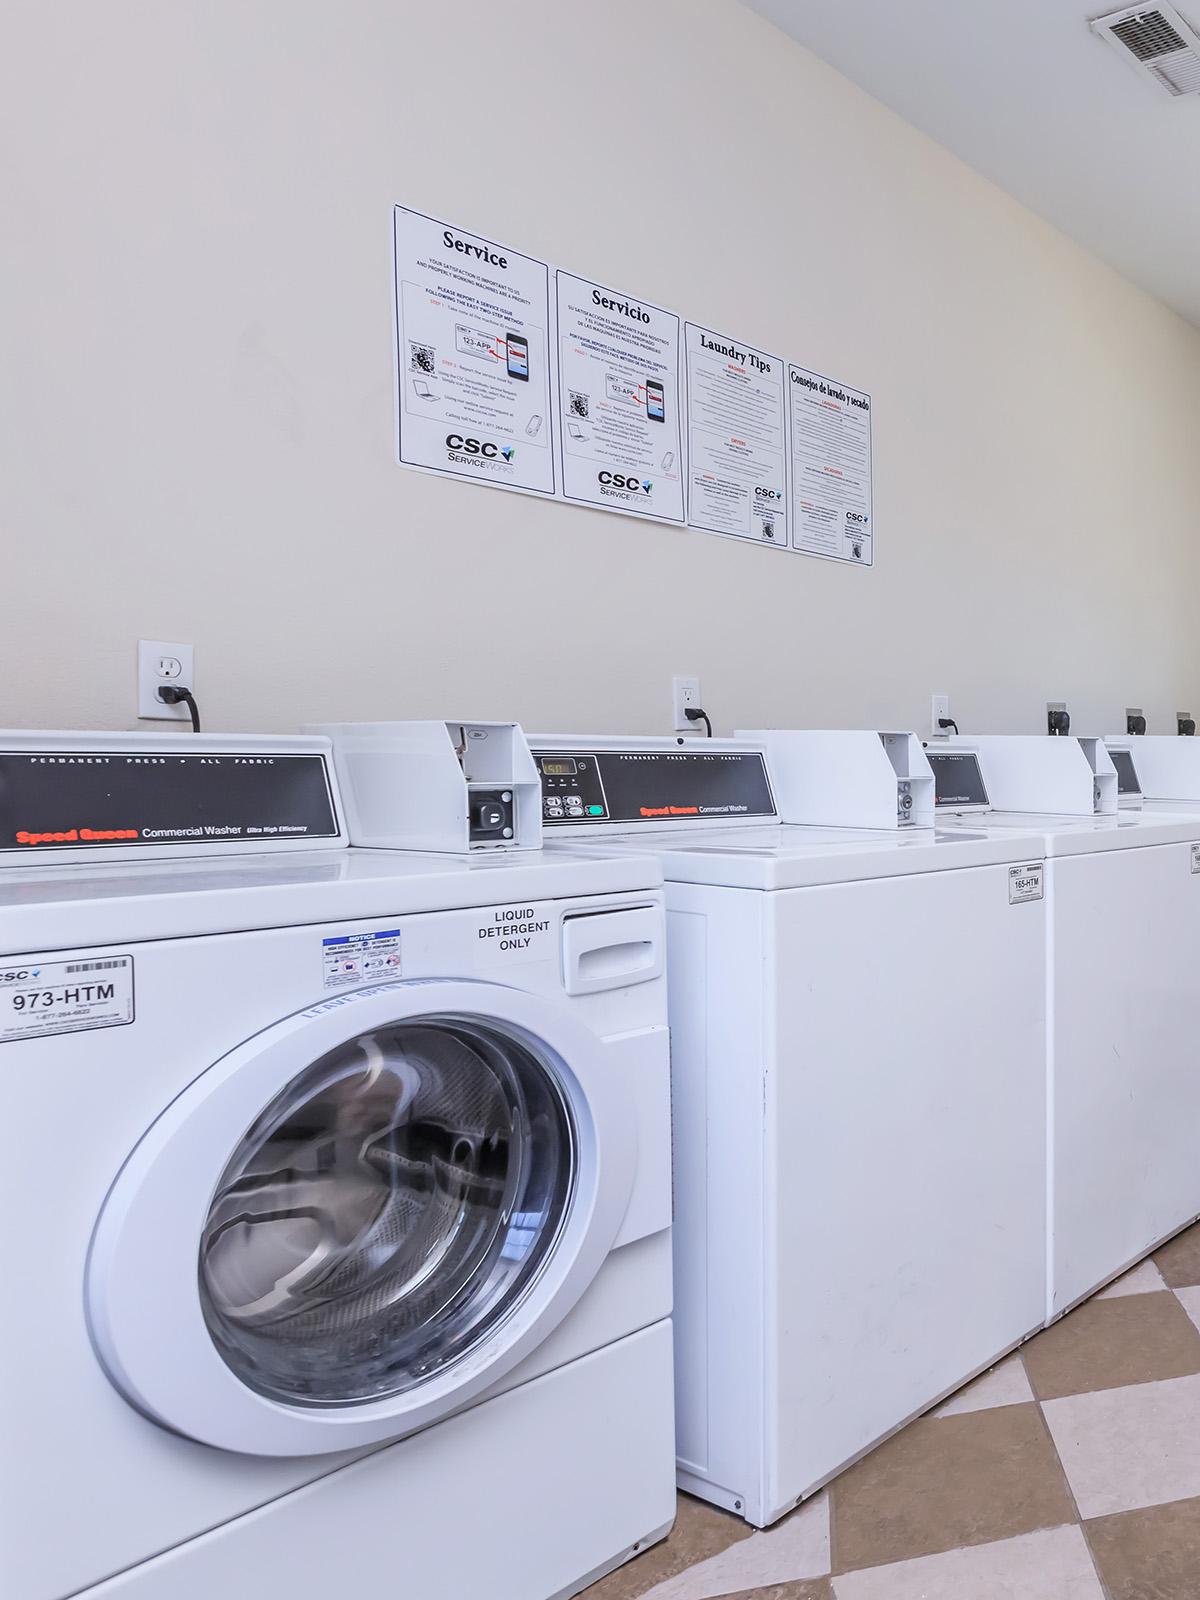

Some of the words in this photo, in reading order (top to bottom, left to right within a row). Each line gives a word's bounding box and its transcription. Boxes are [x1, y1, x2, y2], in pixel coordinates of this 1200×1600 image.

[443, 231, 508, 269] Service
[426, 288, 455, 303] FOLLOWING
[467, 302, 479, 311] EASY
[438, 286, 456, 296] PLEASE
[457, 292, 475, 303] REPORT
[480, 301, 498, 311] SERVICE
[500, 307, 513, 316] ISSUE
[592, 289, 650, 324] Servicio
[700, 334, 746, 365] Laundry
[749, 354, 771, 373] Tips
[791, 370, 818, 392] Consejos
[819, 382, 826, 394] de
[827, 385, 845, 402] lavado
[846, 394, 850, 406] y
[851, 395, 869, 411] secado
[445, 434, 498, 458] CSC
[598, 471, 639, 491] CSC
[755, 487, 775, 499] CSC
[846, 512, 863, 522] CSC
[15, 828, 78, 845] Speed
[79, 828, 138, 840] Queen
[142, 826, 203, 838] Commercial
[204, 826, 242, 835] Washer
[278, 825, 308, 833] Efficiency
[495, 909, 534, 922] LIQUID
[348, 934, 376, 942] NOTICE
[478, 921, 550, 939] DETERGENT
[500, 938, 531, 950] ONLY
[13, 984, 114, 1011] 973-HTM
[301, 997, 357, 1019] LEAVE
